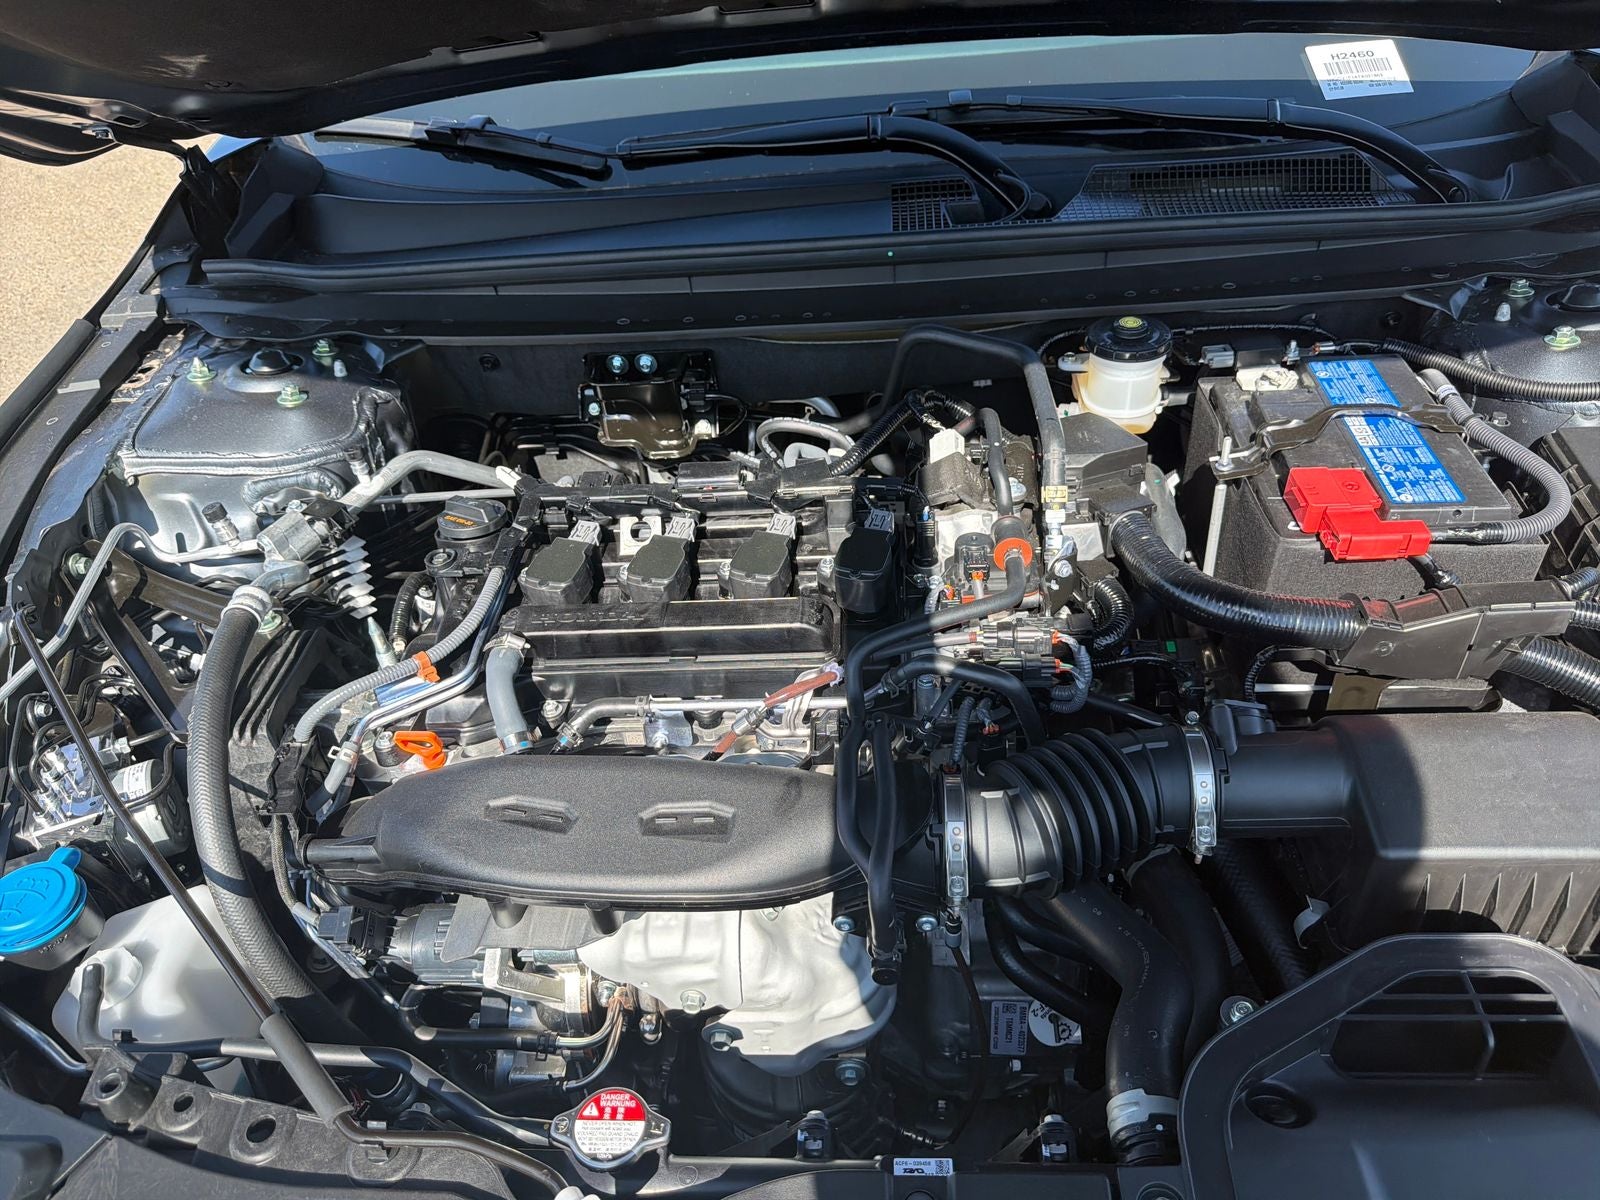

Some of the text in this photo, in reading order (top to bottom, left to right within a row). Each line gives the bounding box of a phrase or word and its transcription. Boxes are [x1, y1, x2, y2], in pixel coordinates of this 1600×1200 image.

[1330, 50, 1375, 61] H2460
[600, 1093, 630, 1101] DANGER
[600, 1100, 636, 1108] WARNUNG
